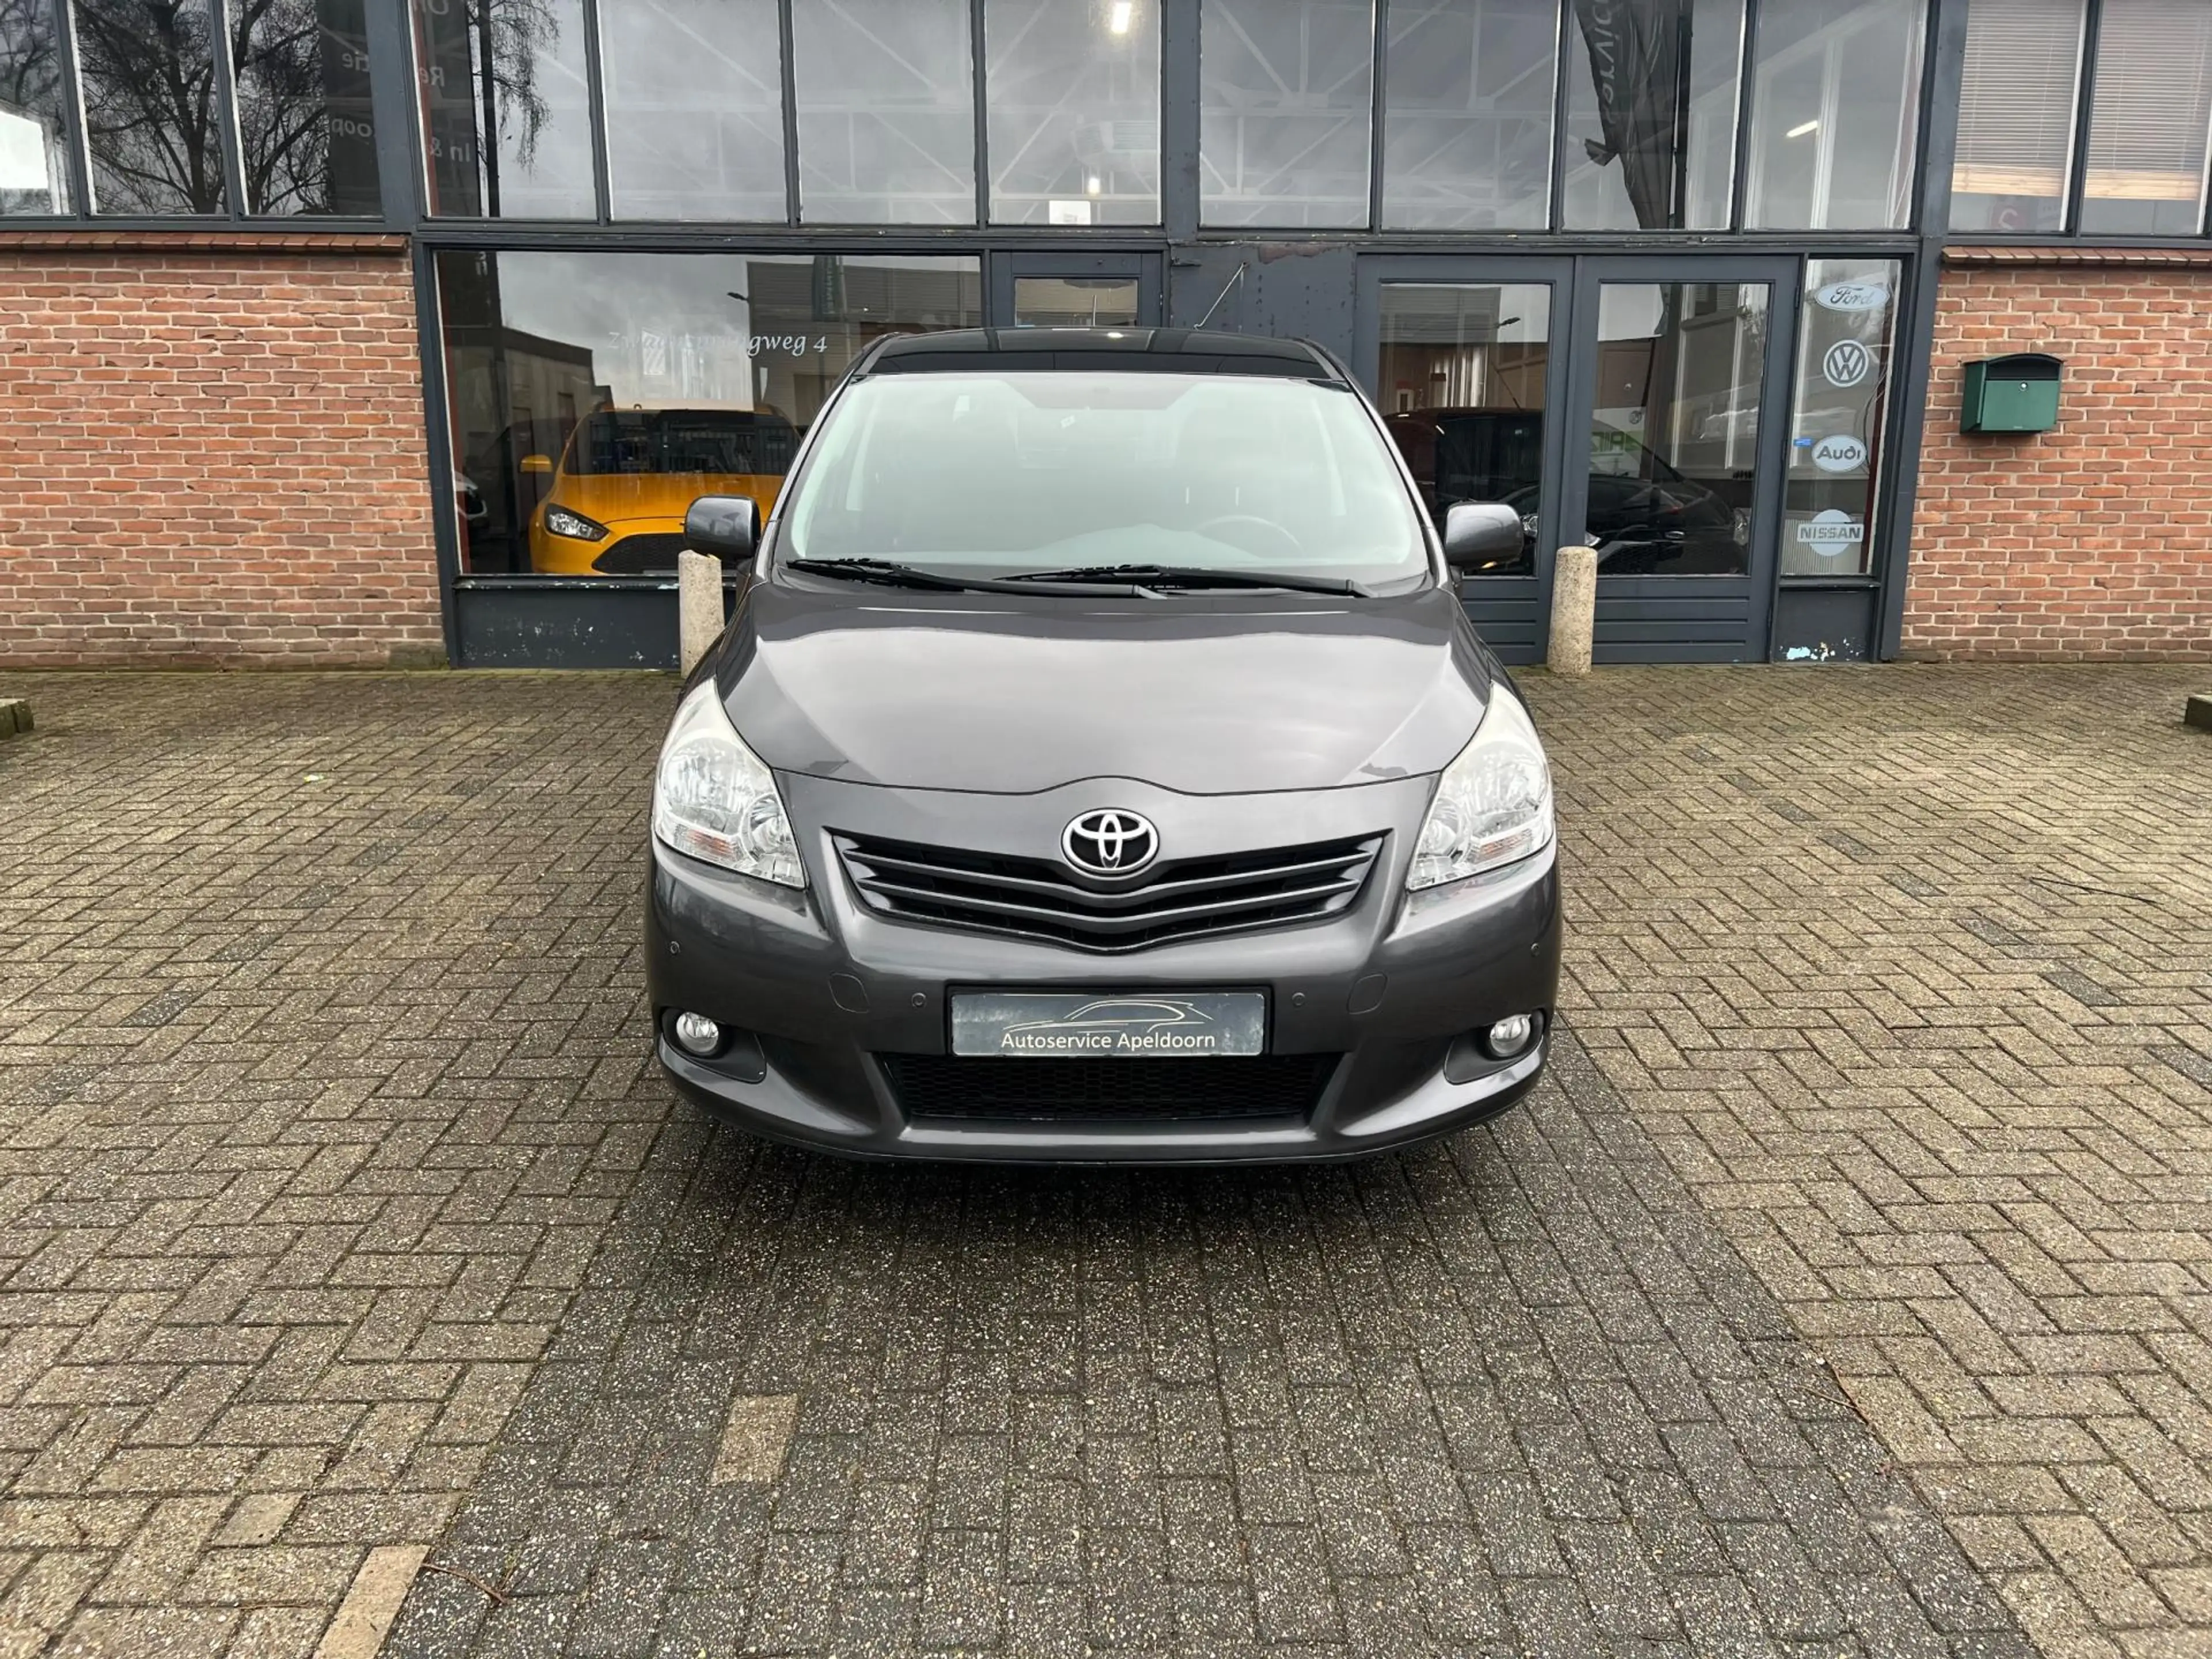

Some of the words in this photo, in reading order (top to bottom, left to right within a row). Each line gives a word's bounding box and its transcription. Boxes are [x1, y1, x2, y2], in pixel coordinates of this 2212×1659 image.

[1830, 286, 1876, 304] Ford
[813, 336, 828, 353] 4
[1816, 445, 1861, 460] Audi
[1800, 526, 1861, 540] NISSAN
[1001, 1032, 1112, 1049] Autoservice
[1117, 1032, 1215, 1051] Apeldoorn
